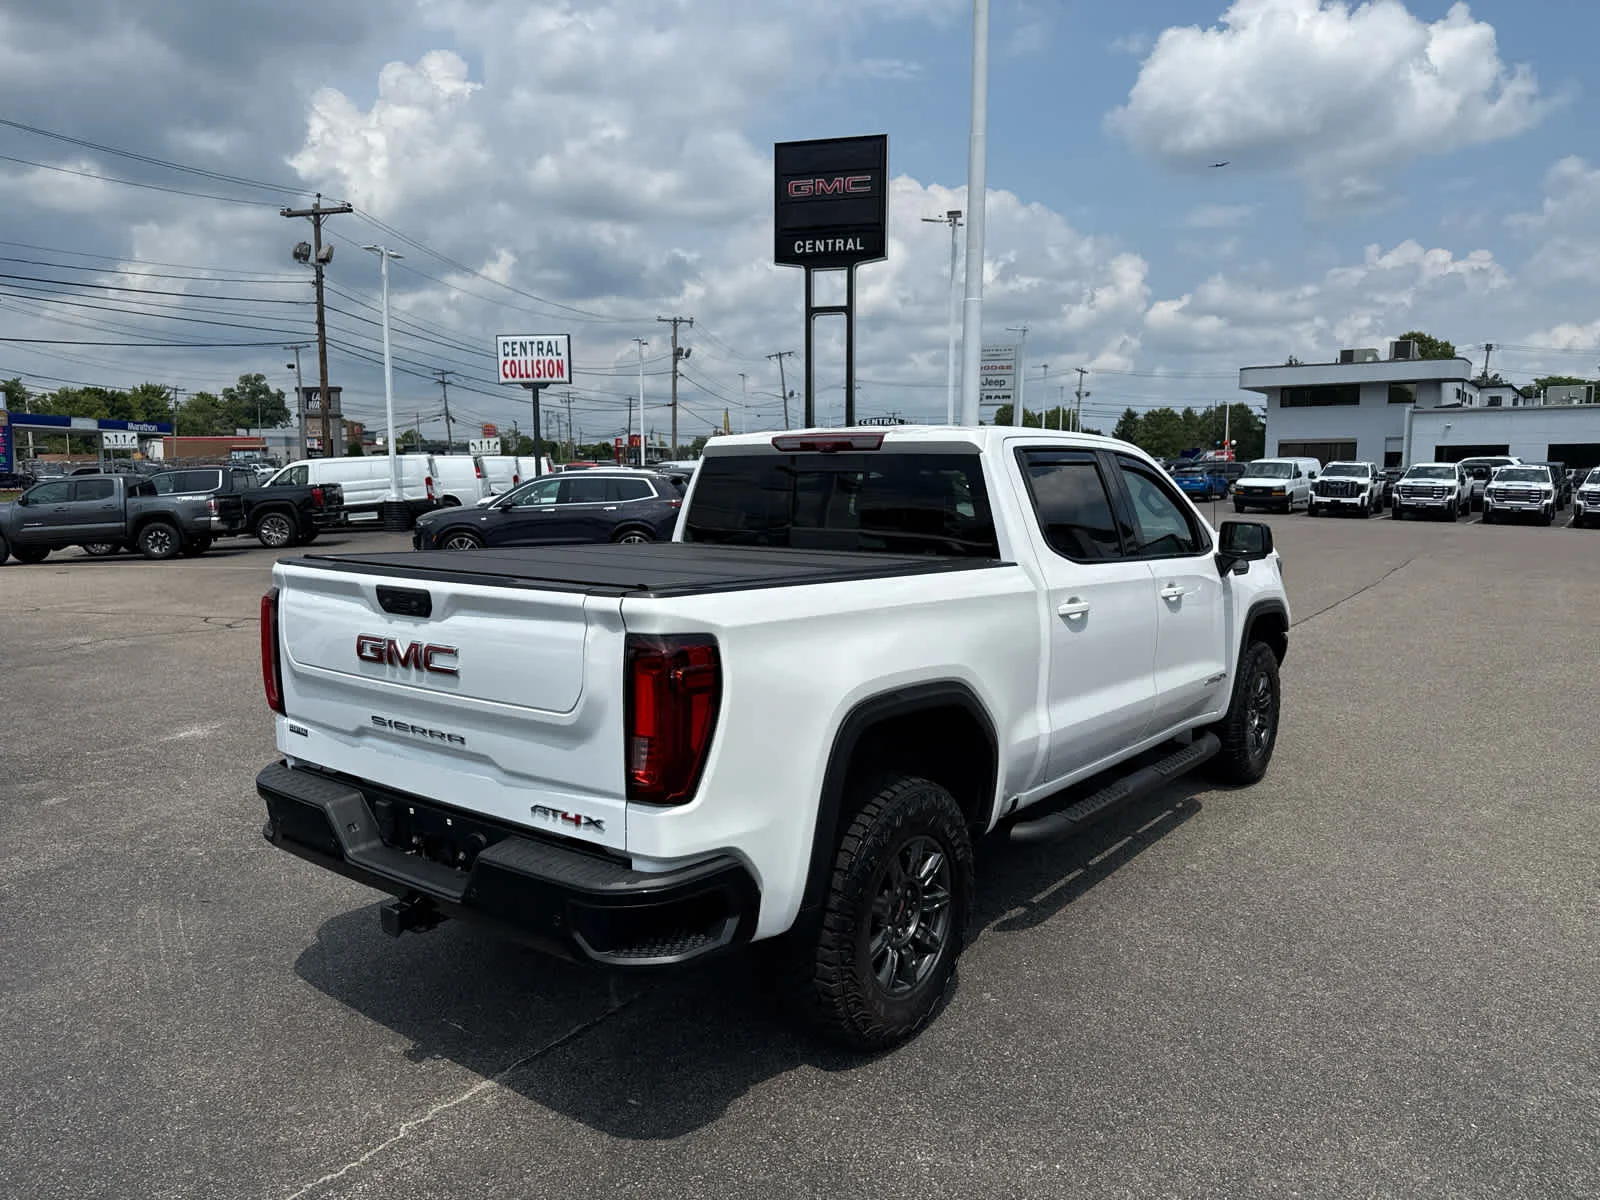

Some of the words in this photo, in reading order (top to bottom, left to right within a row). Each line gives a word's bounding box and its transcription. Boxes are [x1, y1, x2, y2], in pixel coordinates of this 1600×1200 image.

[788, 175, 871, 197] GMC
[794, 237, 865, 254] CENTRAL
[503, 340, 562, 357] CENTRAL
[502, 358, 564, 379] COLLISION
[981, 376, 1006, 388] Jeep
[127, 422, 158, 432] Marathon
[860, 417, 901, 425] CENTRAL
[356, 632, 460, 678] GMC
[371, 715, 466, 745] SIERRA
[530, 804, 606, 832] AT4X
